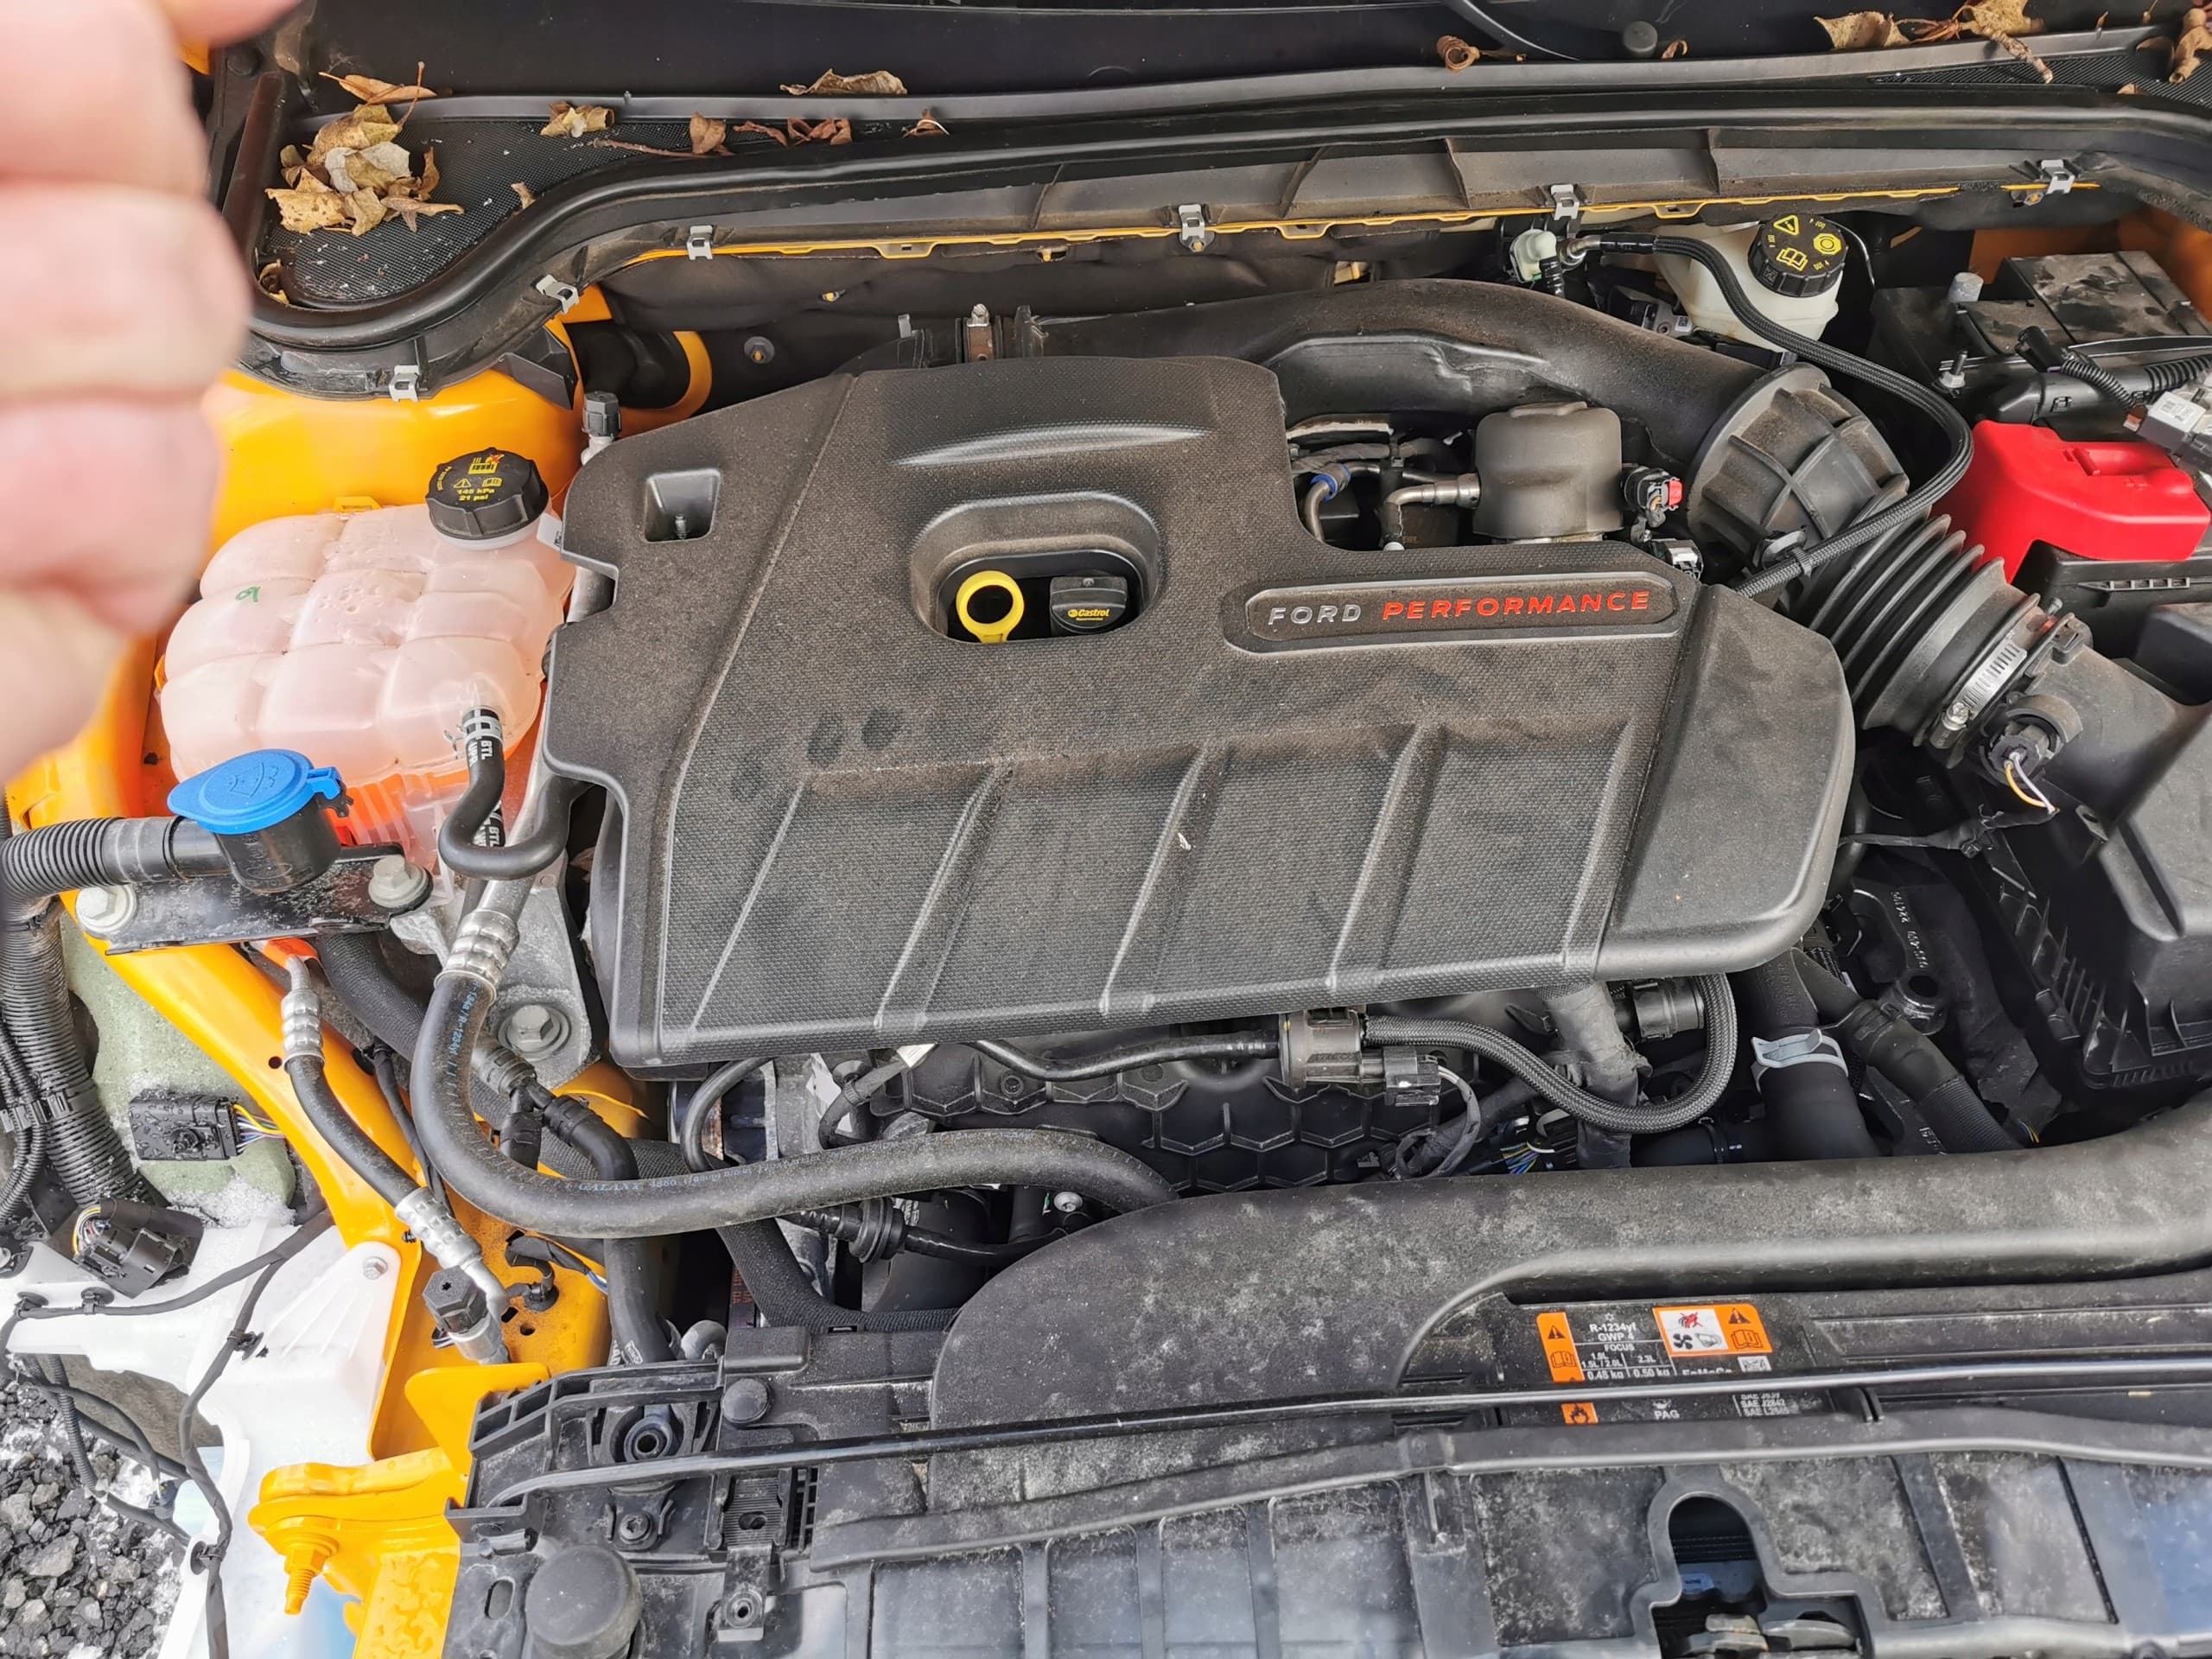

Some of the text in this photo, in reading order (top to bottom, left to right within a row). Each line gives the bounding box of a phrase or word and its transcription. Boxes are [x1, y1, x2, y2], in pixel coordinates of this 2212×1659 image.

[1077, 608, 1110, 617] Castrol
[1268, 591, 1650, 626] FORD PERFORMANCE
[467, 741, 479, 768] UPR
[480, 740, 493, 760] BTL
[488, 825, 500, 847] BTL
[1589, 1322, 1637, 1332] R-1234yf
[1598, 1332, 1624, 1342] GWP
[1633, 1369, 1655, 1378] 0.50
[1652, 1410, 1681, 1420] PAG
